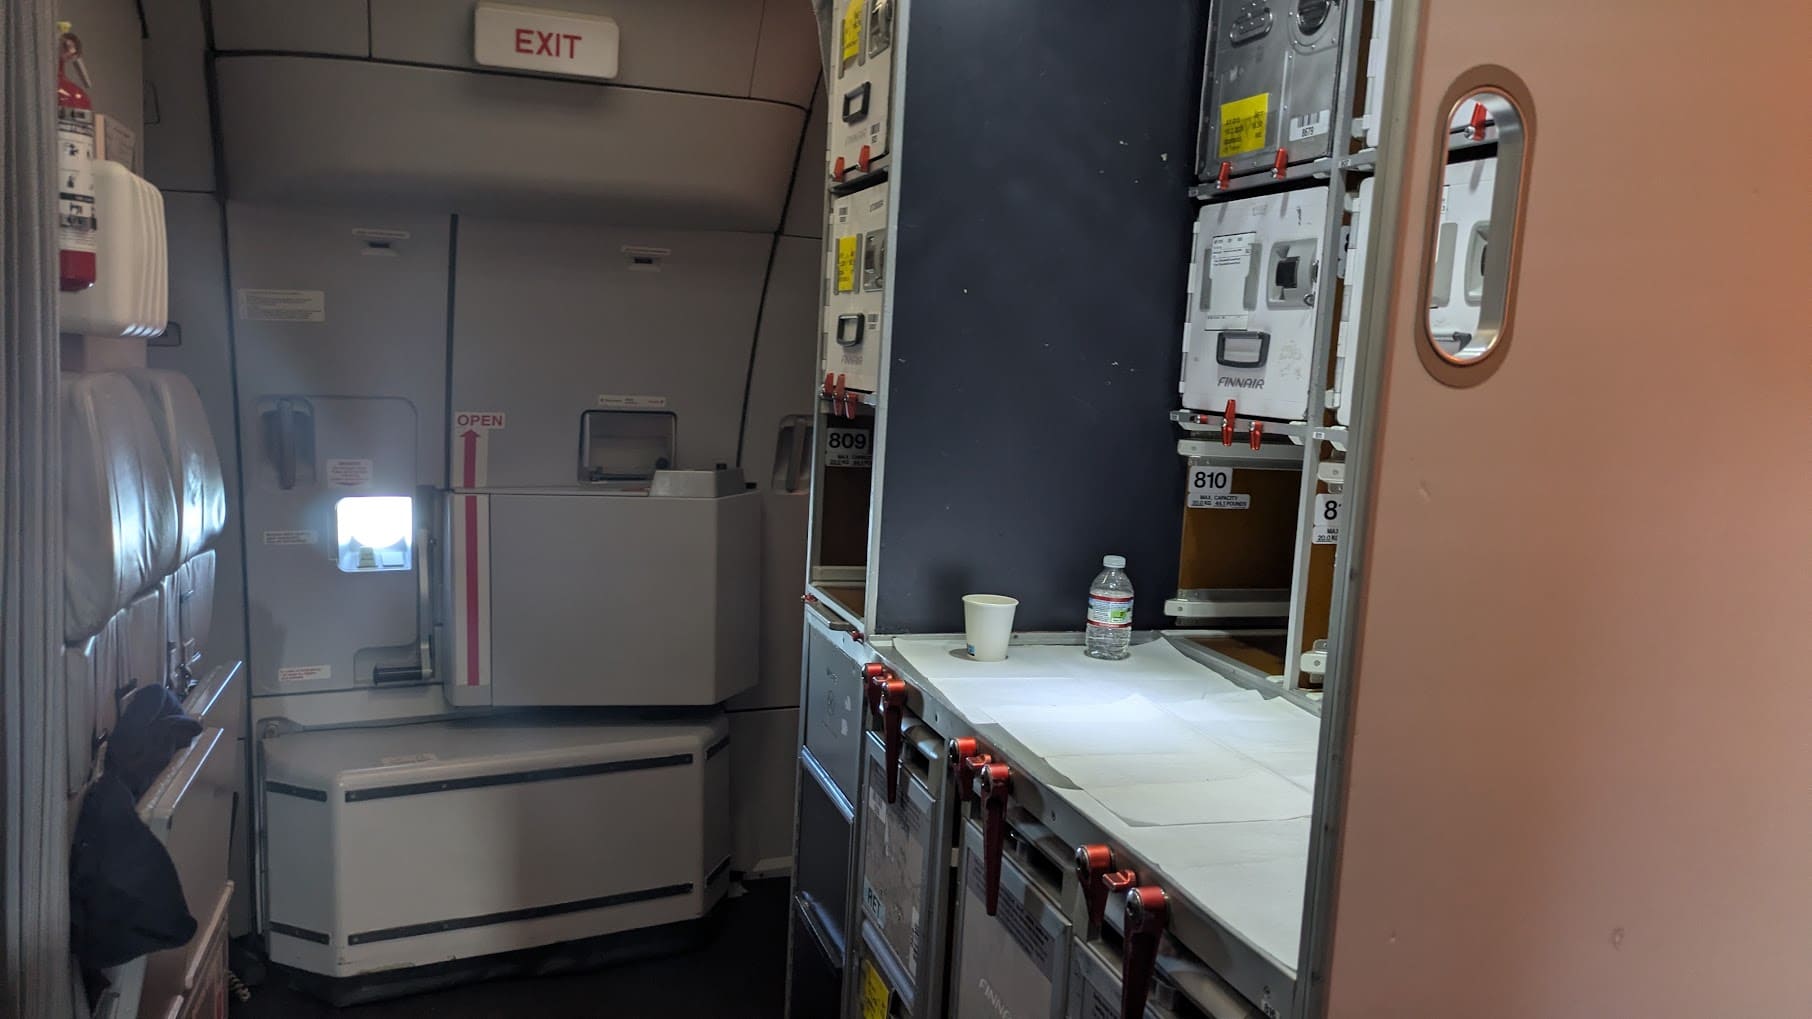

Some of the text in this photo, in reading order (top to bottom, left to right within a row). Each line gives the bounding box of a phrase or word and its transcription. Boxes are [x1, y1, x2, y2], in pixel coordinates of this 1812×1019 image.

[515, 28, 582, 59] EXIT
[1217, 376, 1265, 390] FINNAIR
[457, 414, 503, 426] OPEN
[828, 432, 866, 449] 809
[1194, 471, 1227, 489] 810
[1324, 500, 1342, 520] 8
[866, 887, 881, 919] RET
